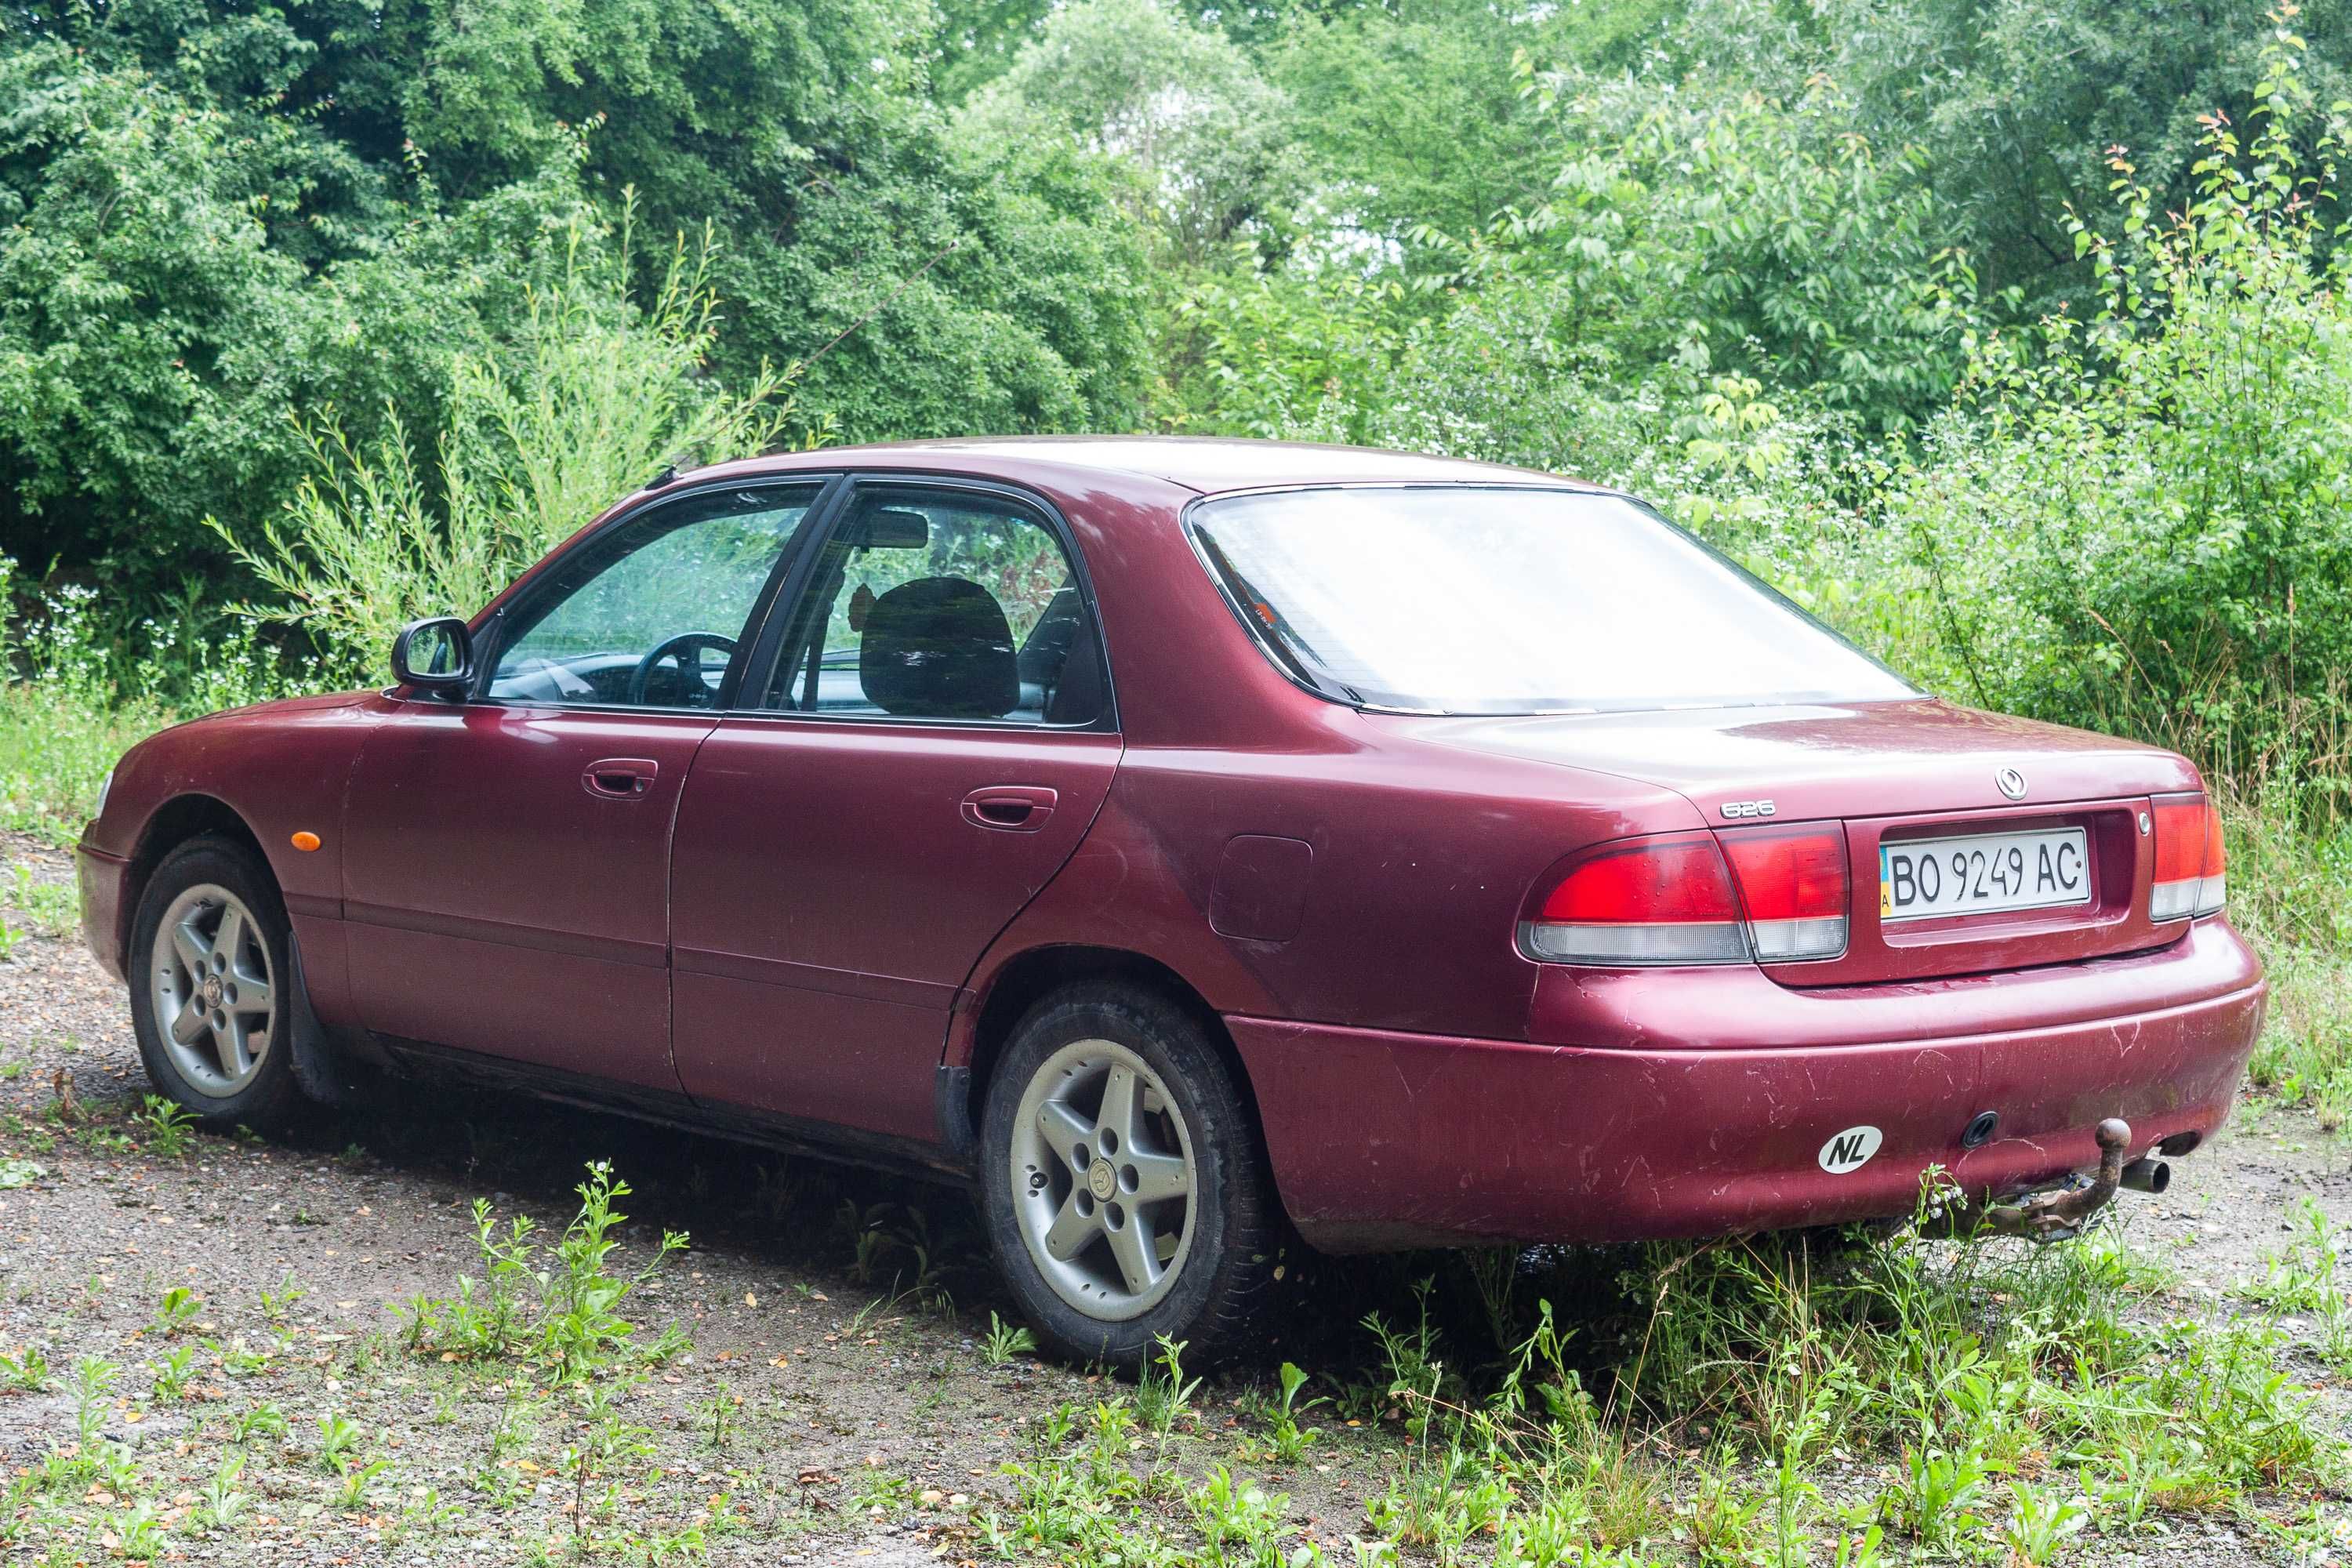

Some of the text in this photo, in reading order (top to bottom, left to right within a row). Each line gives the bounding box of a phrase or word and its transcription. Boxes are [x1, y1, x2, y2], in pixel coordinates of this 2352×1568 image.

[1720, 800, 1775, 818] 626
[1892, 841, 2078, 906] BO 9249 AC
[1827, 1134, 1865, 1167] NL
